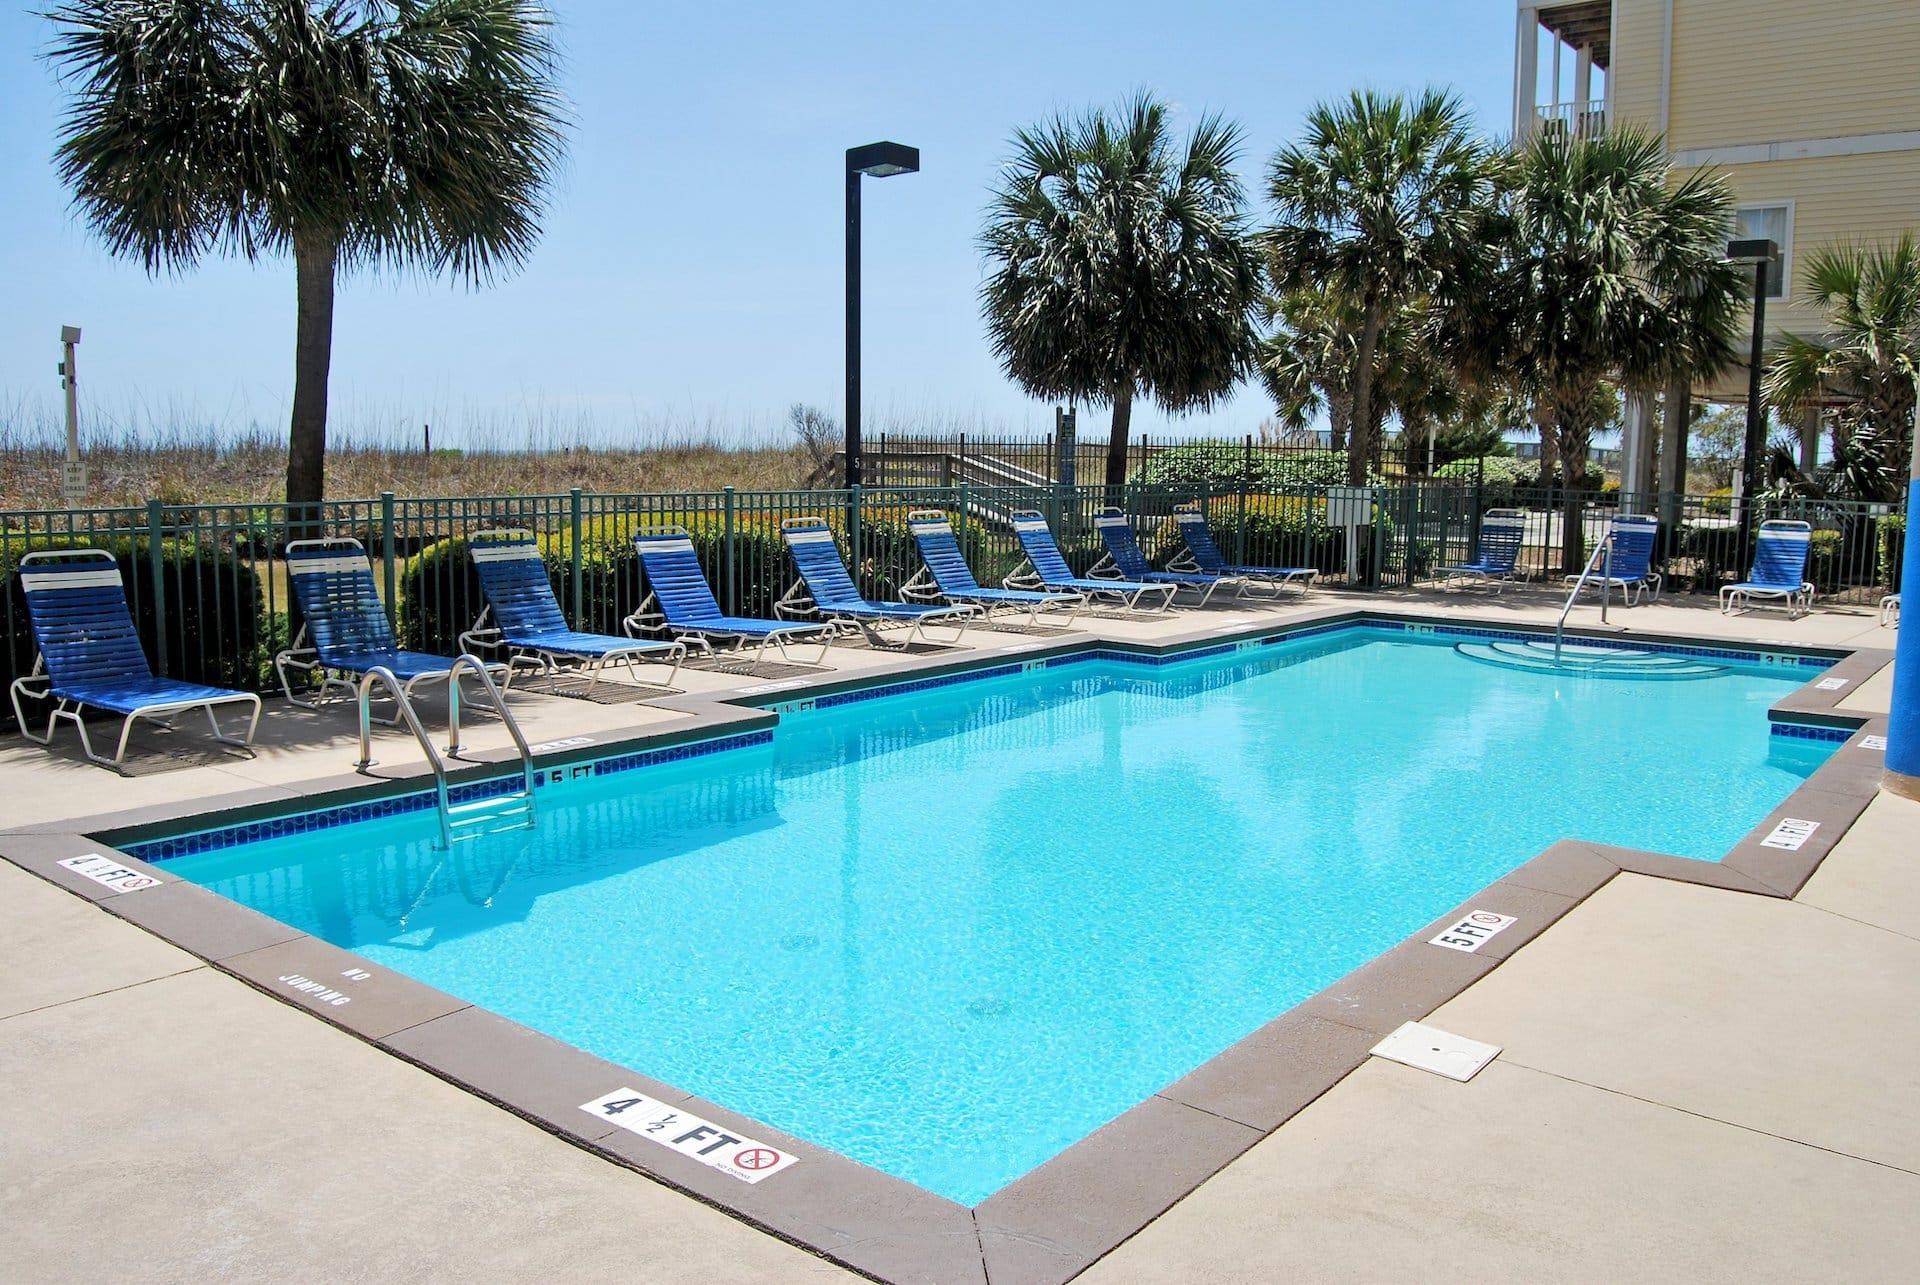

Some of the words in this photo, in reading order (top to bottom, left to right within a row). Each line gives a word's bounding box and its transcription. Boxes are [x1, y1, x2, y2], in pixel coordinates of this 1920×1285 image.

[551, 770, 563, 783] 5
[572, 765, 592, 779] FT
[1779, 825, 1808, 836] FT
[69, 857, 99, 866] 4
[95, 869, 136, 882] FT
[1453, 922, 1493, 938] FT
[1440, 935, 1474, 947] 5
[341, 968, 371, 980] NO
[278, 974, 351, 1006] JUMPING
[602, 1098, 643, 1116] 4
[671, 1125, 742, 1156] FT
